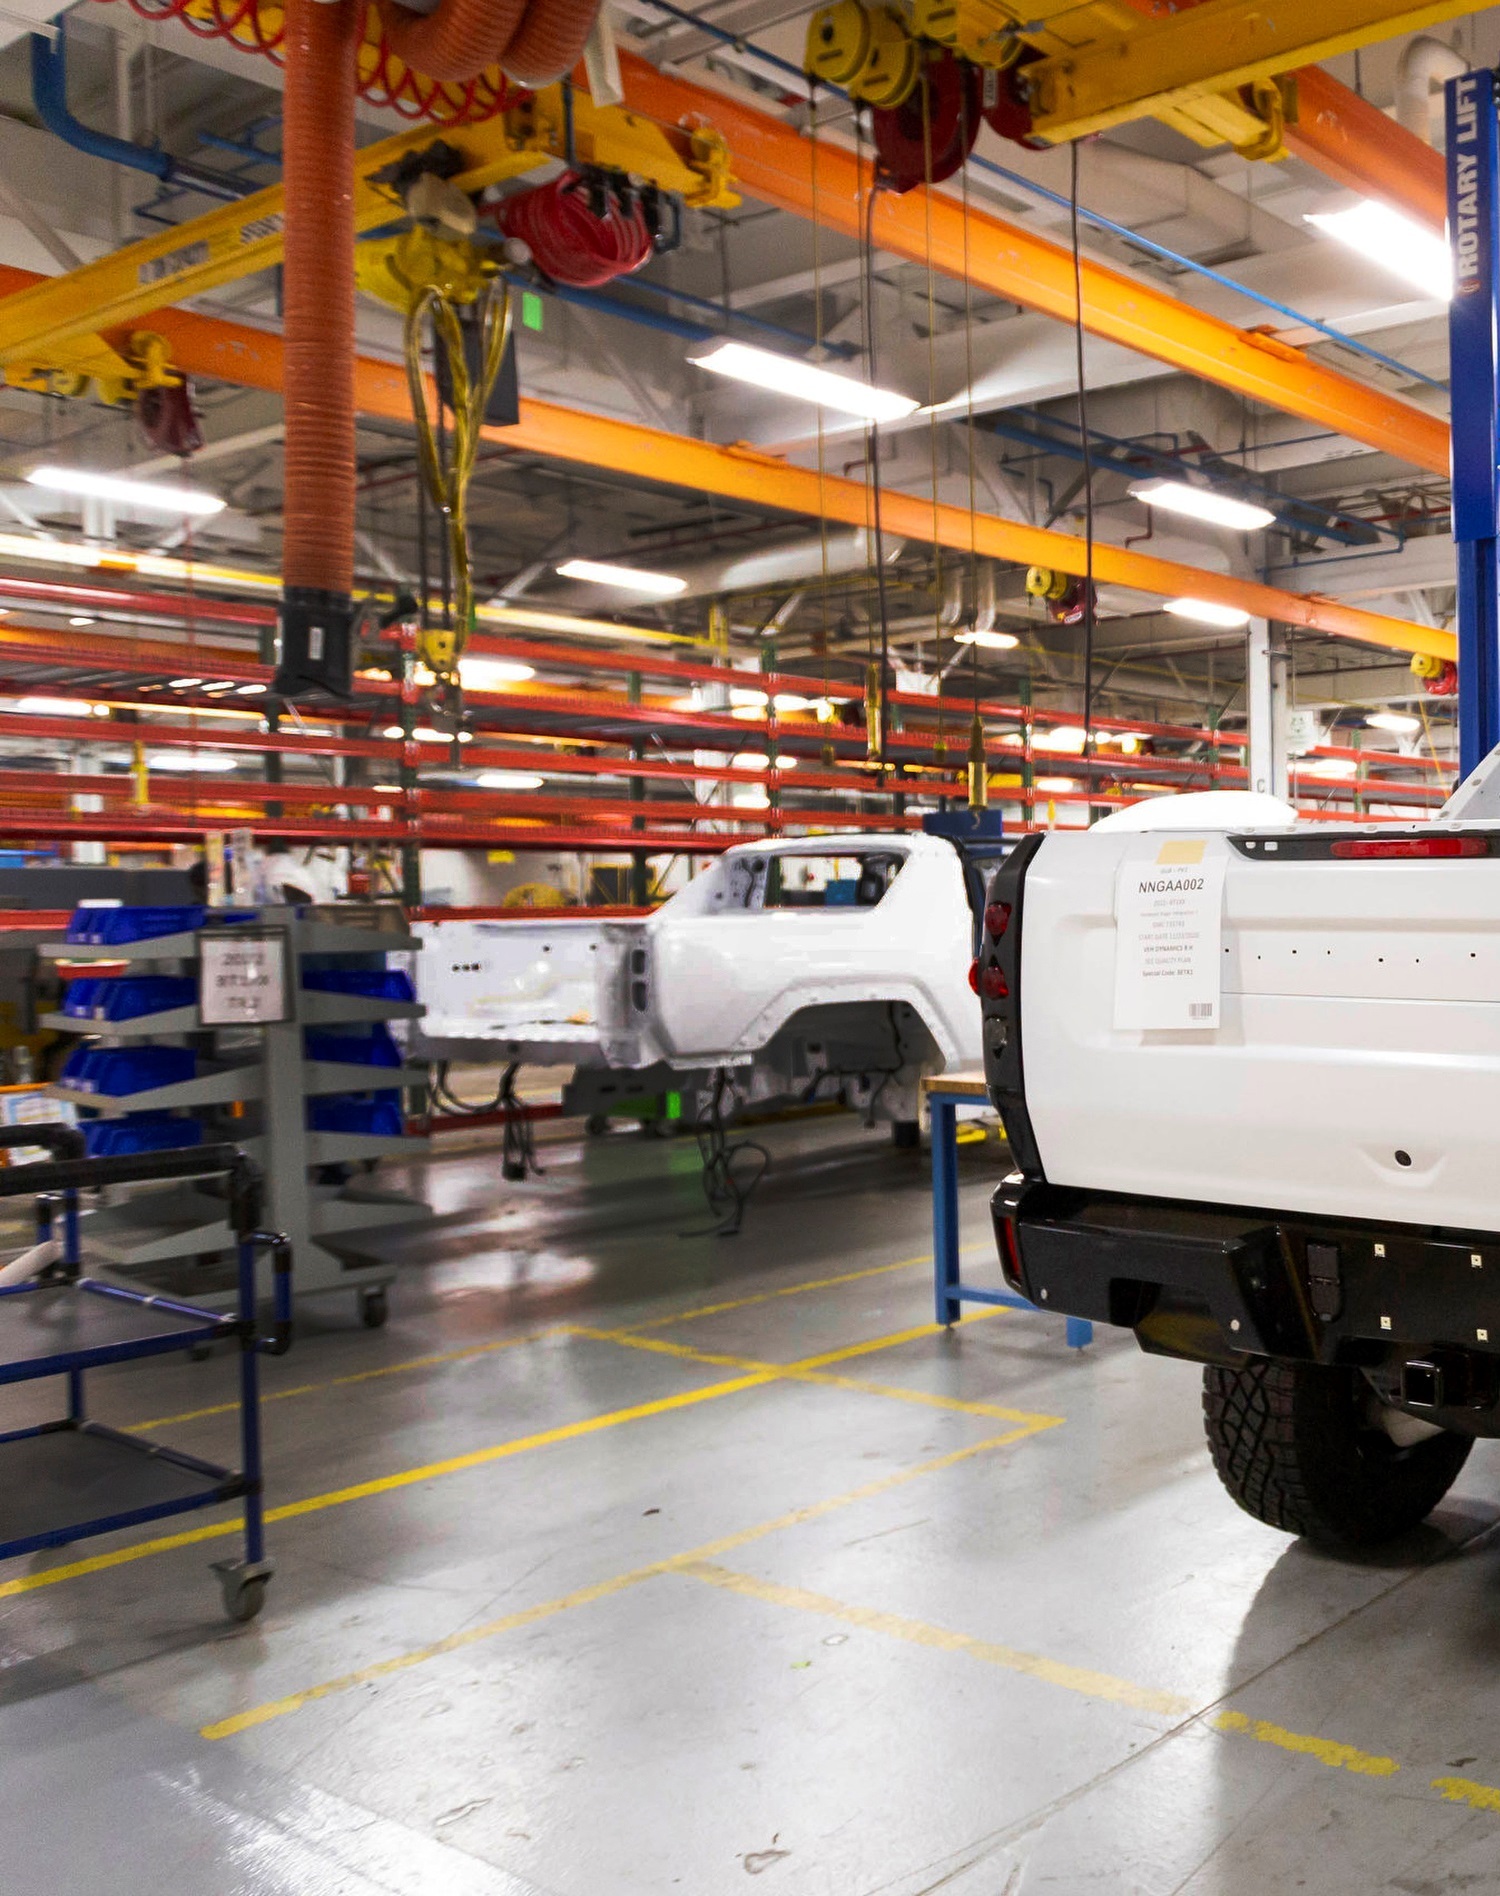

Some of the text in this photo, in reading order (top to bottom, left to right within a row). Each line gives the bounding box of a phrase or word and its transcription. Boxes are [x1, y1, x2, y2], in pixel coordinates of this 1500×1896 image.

[1455, 77, 1479, 143] LIFT
[1456, 152, 1480, 276] ROTARY
[1138, 878, 1204, 894] NNGAA002
